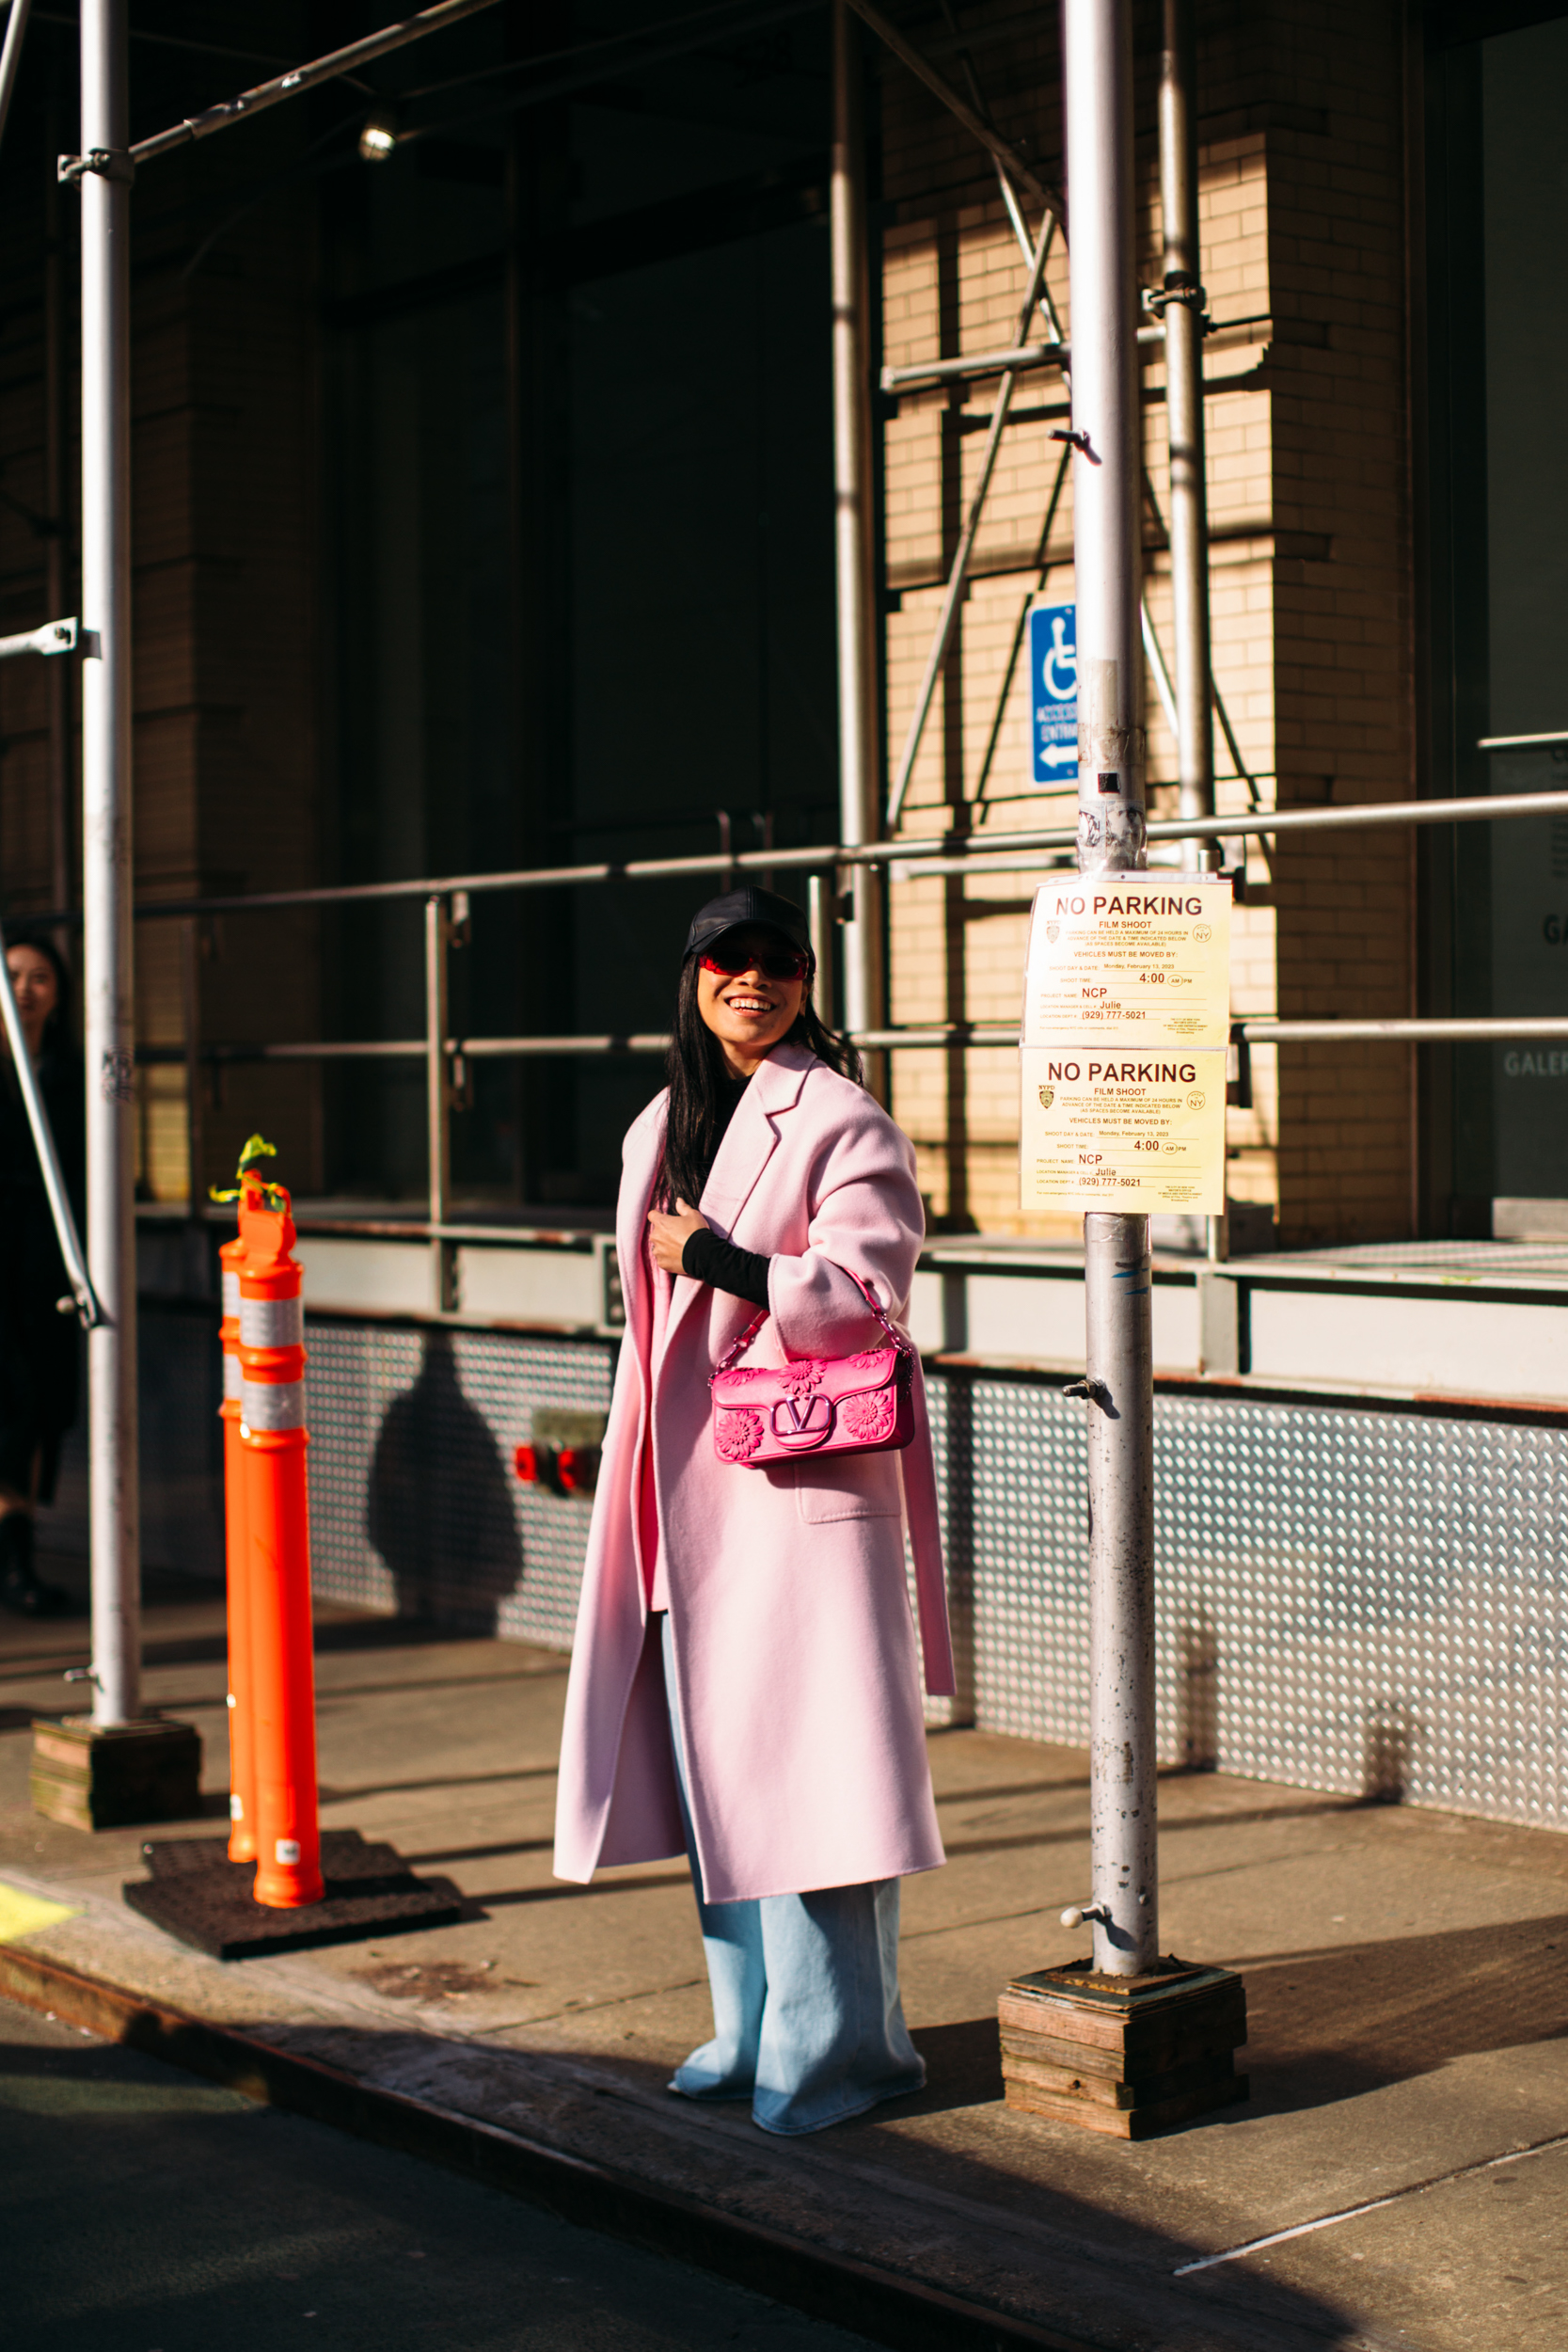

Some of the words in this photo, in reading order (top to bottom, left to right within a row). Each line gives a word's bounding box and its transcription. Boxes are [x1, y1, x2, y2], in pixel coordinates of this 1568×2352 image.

[1056, 898, 1085, 915] NO
[1094, 897, 1202, 915] PARKING
[1140, 973, 1164, 983] 4:00
[1082, 988, 1107, 998] NCP
[1082, 1011, 1103, 1020] (929)
[1048, 1062, 1080, 1081] NO
[1089, 1063, 1196, 1082] PARKING
[1134, 1140, 1159, 1151] 4:00
[1079, 1154, 1102, 1164] NCP
[1079, 1177, 1099, 1186] (929)
[1102, 1178, 1140, 1186] 777-5021
